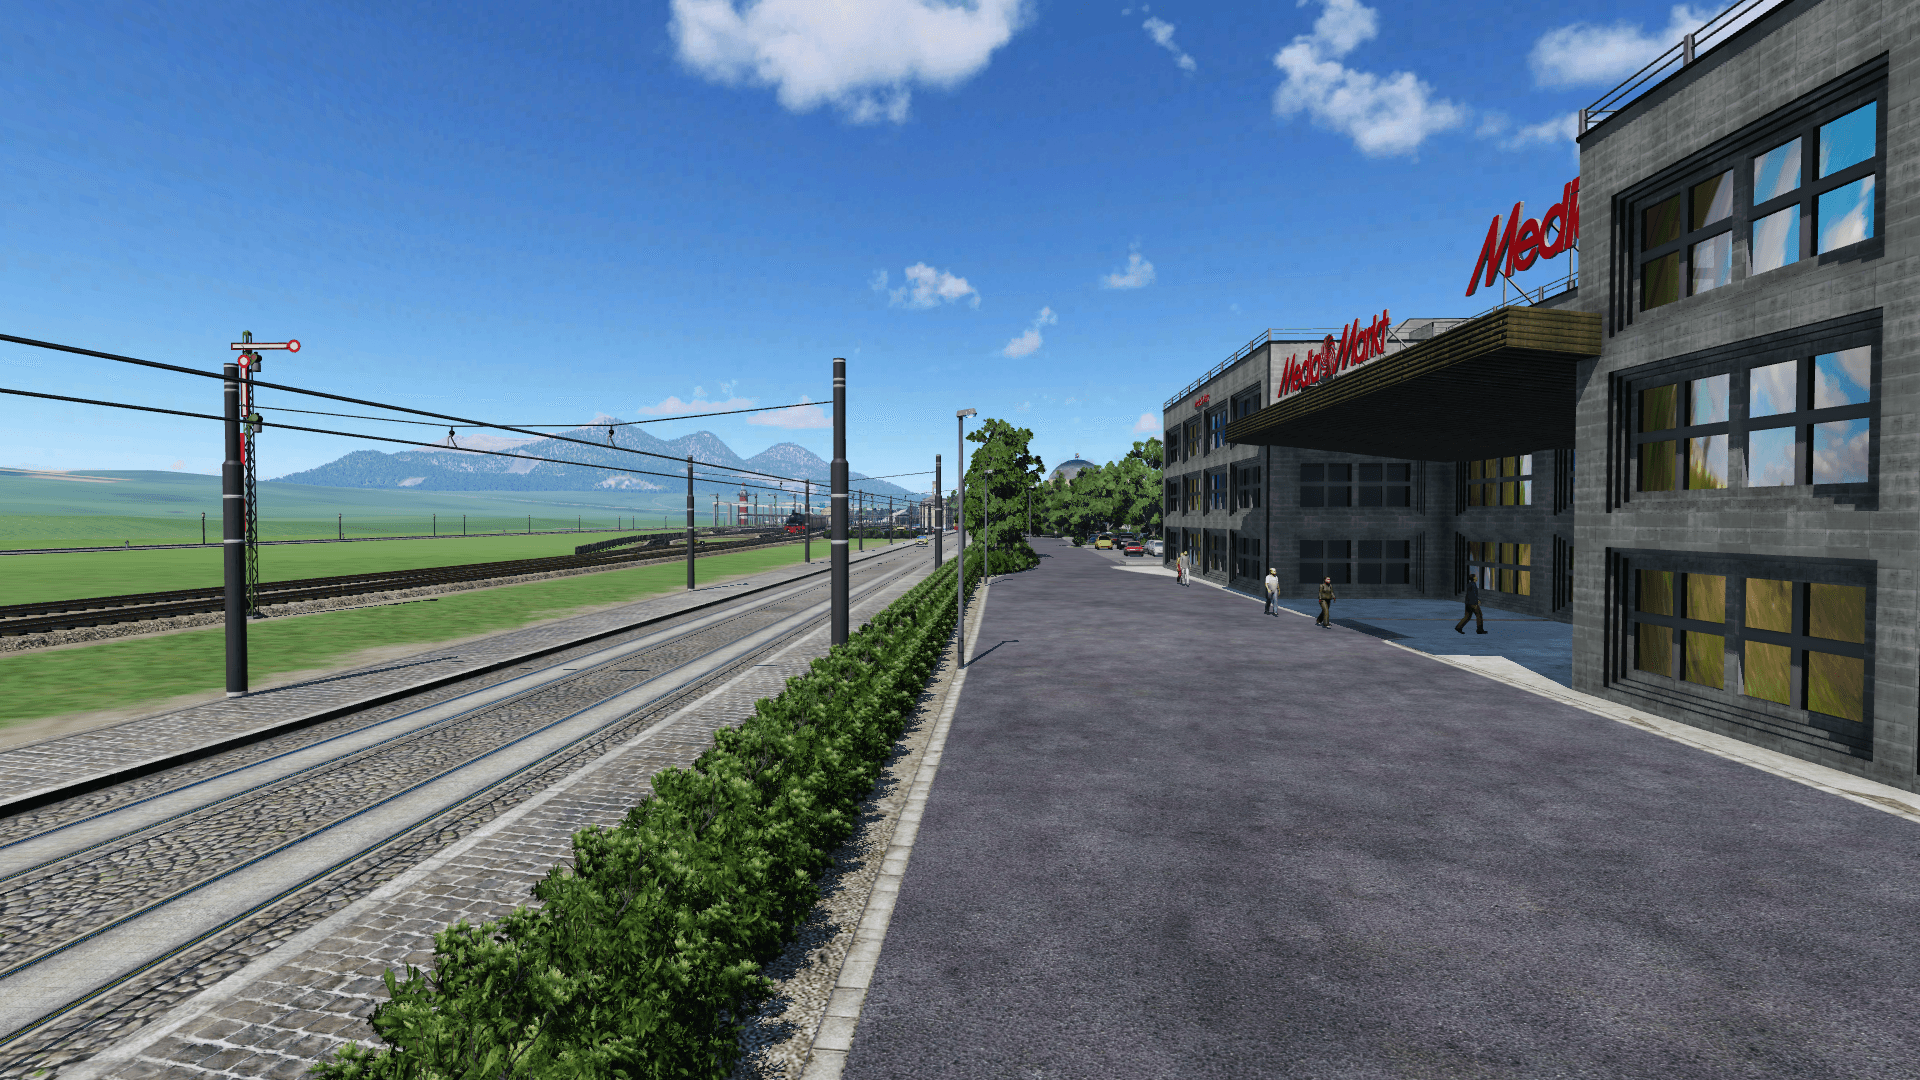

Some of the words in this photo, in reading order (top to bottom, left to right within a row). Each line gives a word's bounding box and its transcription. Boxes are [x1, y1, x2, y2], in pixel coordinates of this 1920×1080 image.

[1465, 176, 1580, 297] Medi
[1278, 349, 1321, 398] Media
[1332, 309, 1391, 374] Markt
